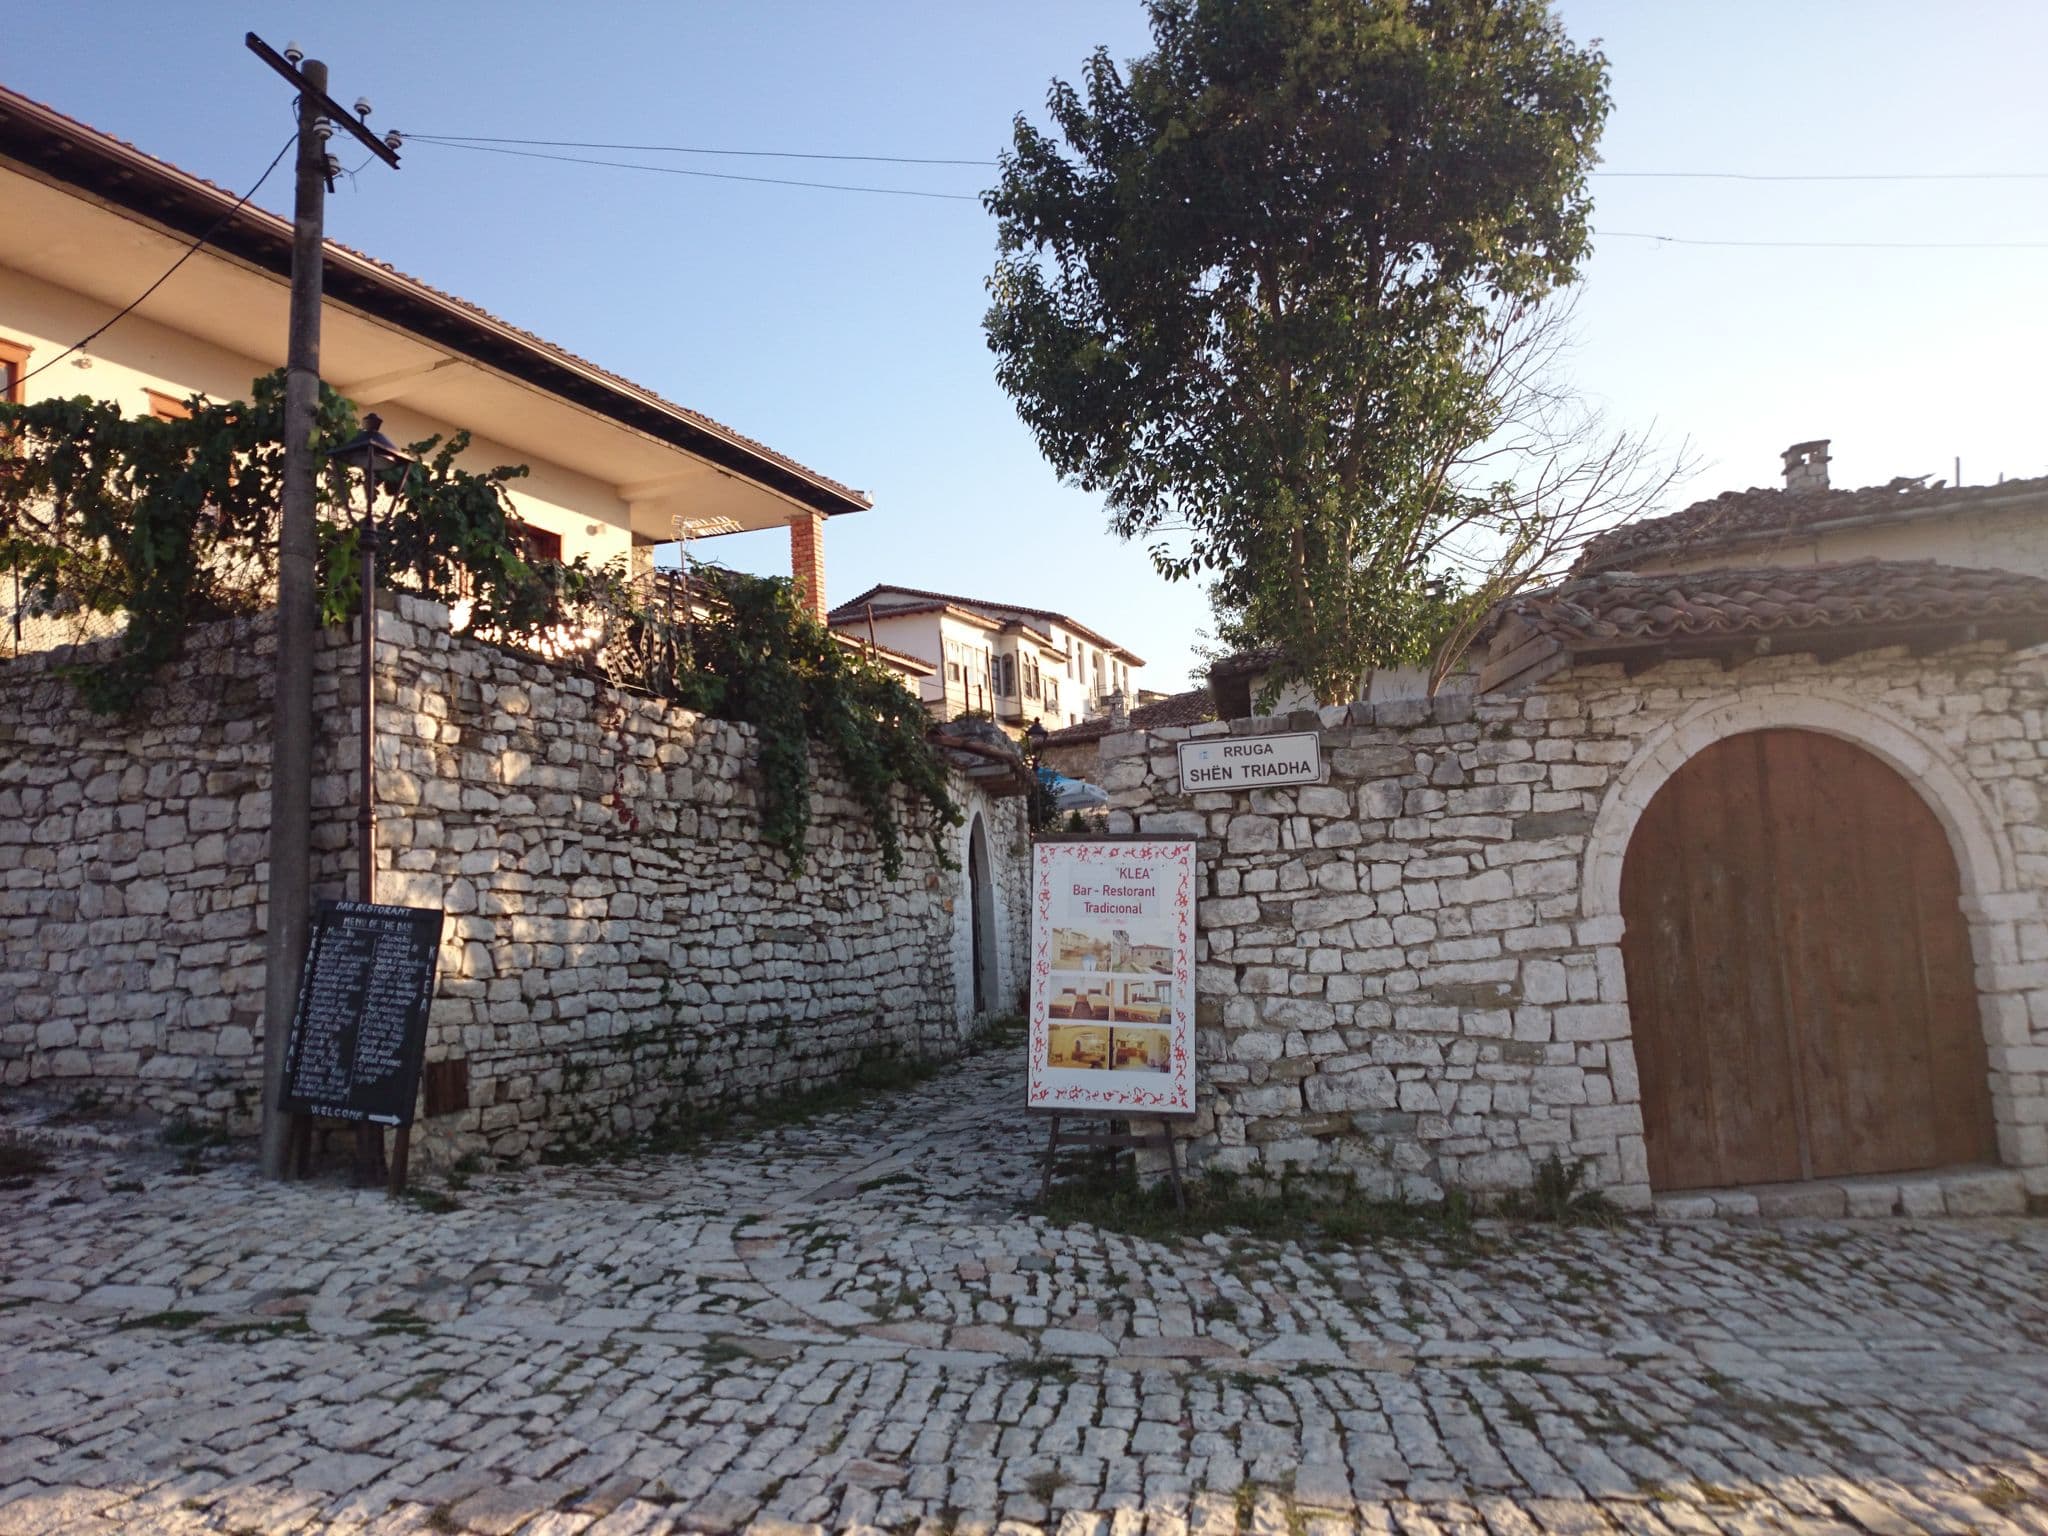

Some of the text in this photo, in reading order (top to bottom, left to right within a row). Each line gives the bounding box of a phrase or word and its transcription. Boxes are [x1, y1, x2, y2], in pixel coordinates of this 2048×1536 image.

[1223, 743, 1273, 758] RRUGA
[1190, 760, 1312, 782] SHËN TRIADHA
[1072, 884, 1092, 896] Bar
[1102, 884, 1156, 897] Restorant
[335, 901, 412, 917] BAR RESTORANT
[1084, 901, 1143, 915] Tradicional
